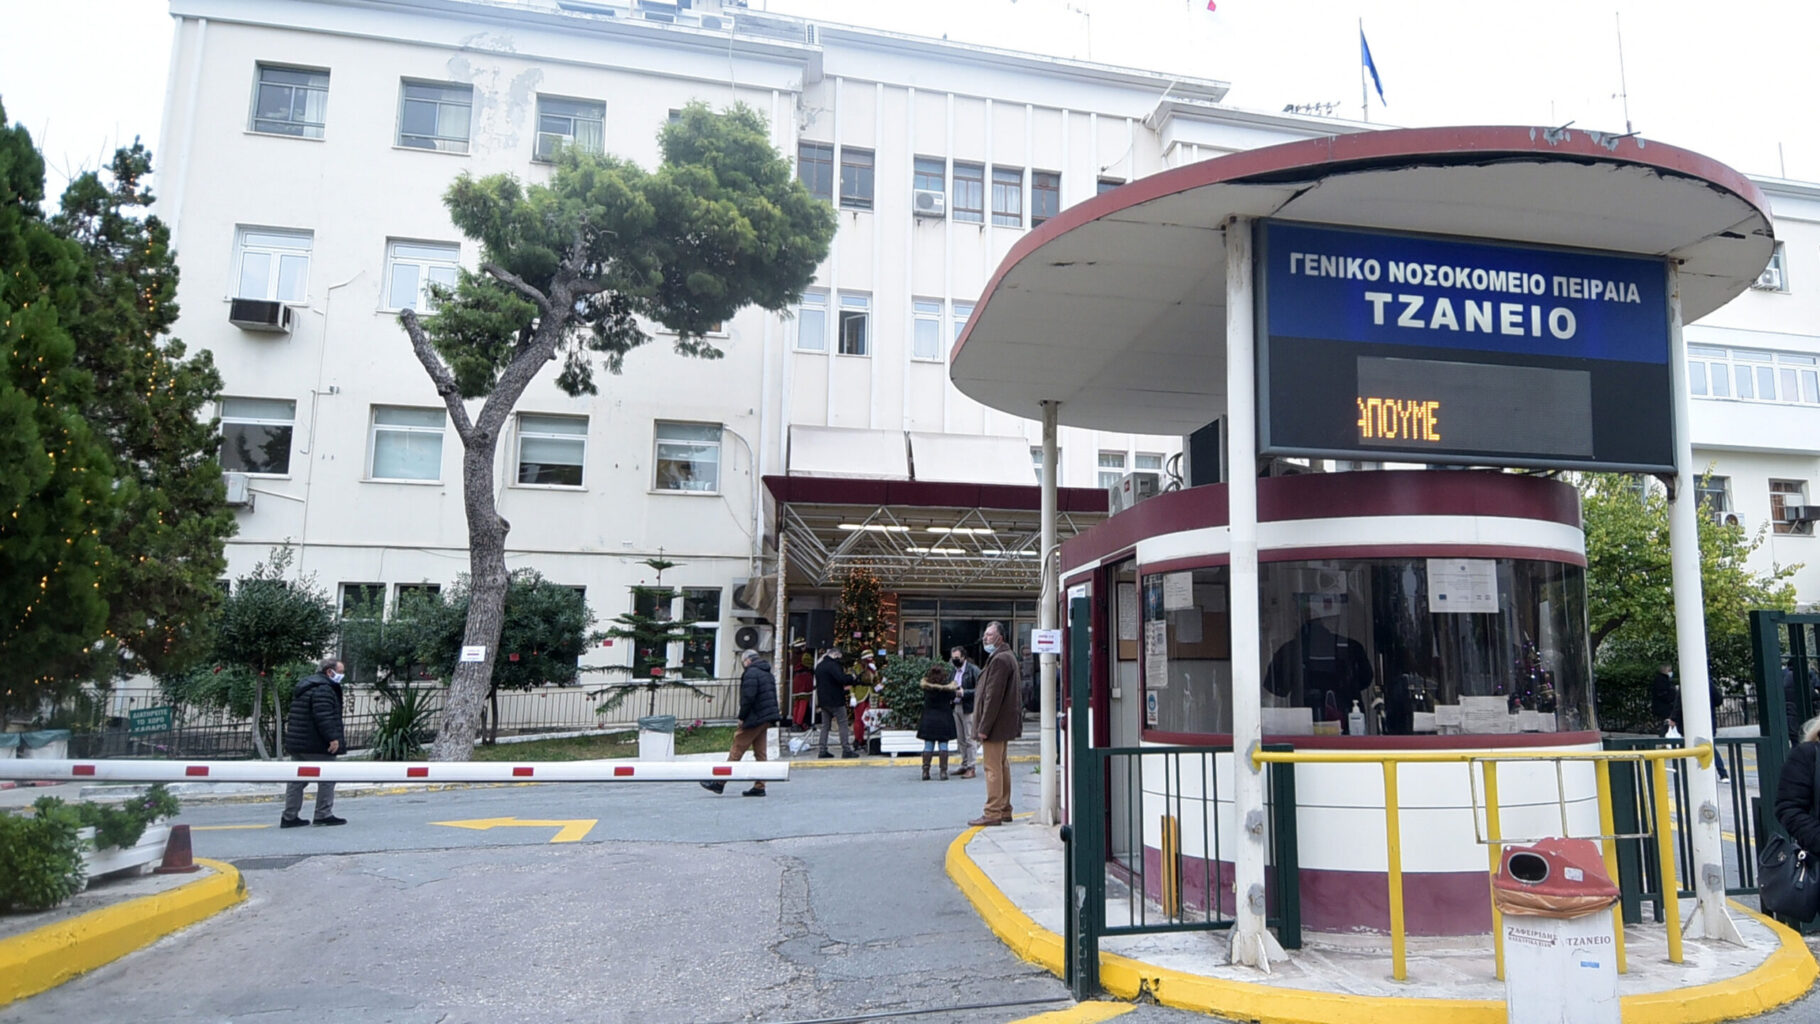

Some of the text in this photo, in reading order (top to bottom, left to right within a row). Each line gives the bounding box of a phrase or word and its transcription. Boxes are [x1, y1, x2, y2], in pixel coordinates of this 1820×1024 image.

[1290, 252, 1641, 304] ΓΕΝΙΚΟ ΝΟΣΟΚΟΜΕΙΟ ΠΕΙΡΑΙΑ
[1365, 292, 1577, 340] ΤΖΑΝΕΙΟ
[1567, 936, 1611, 946] ΤΖΑΝΕΙΟ
